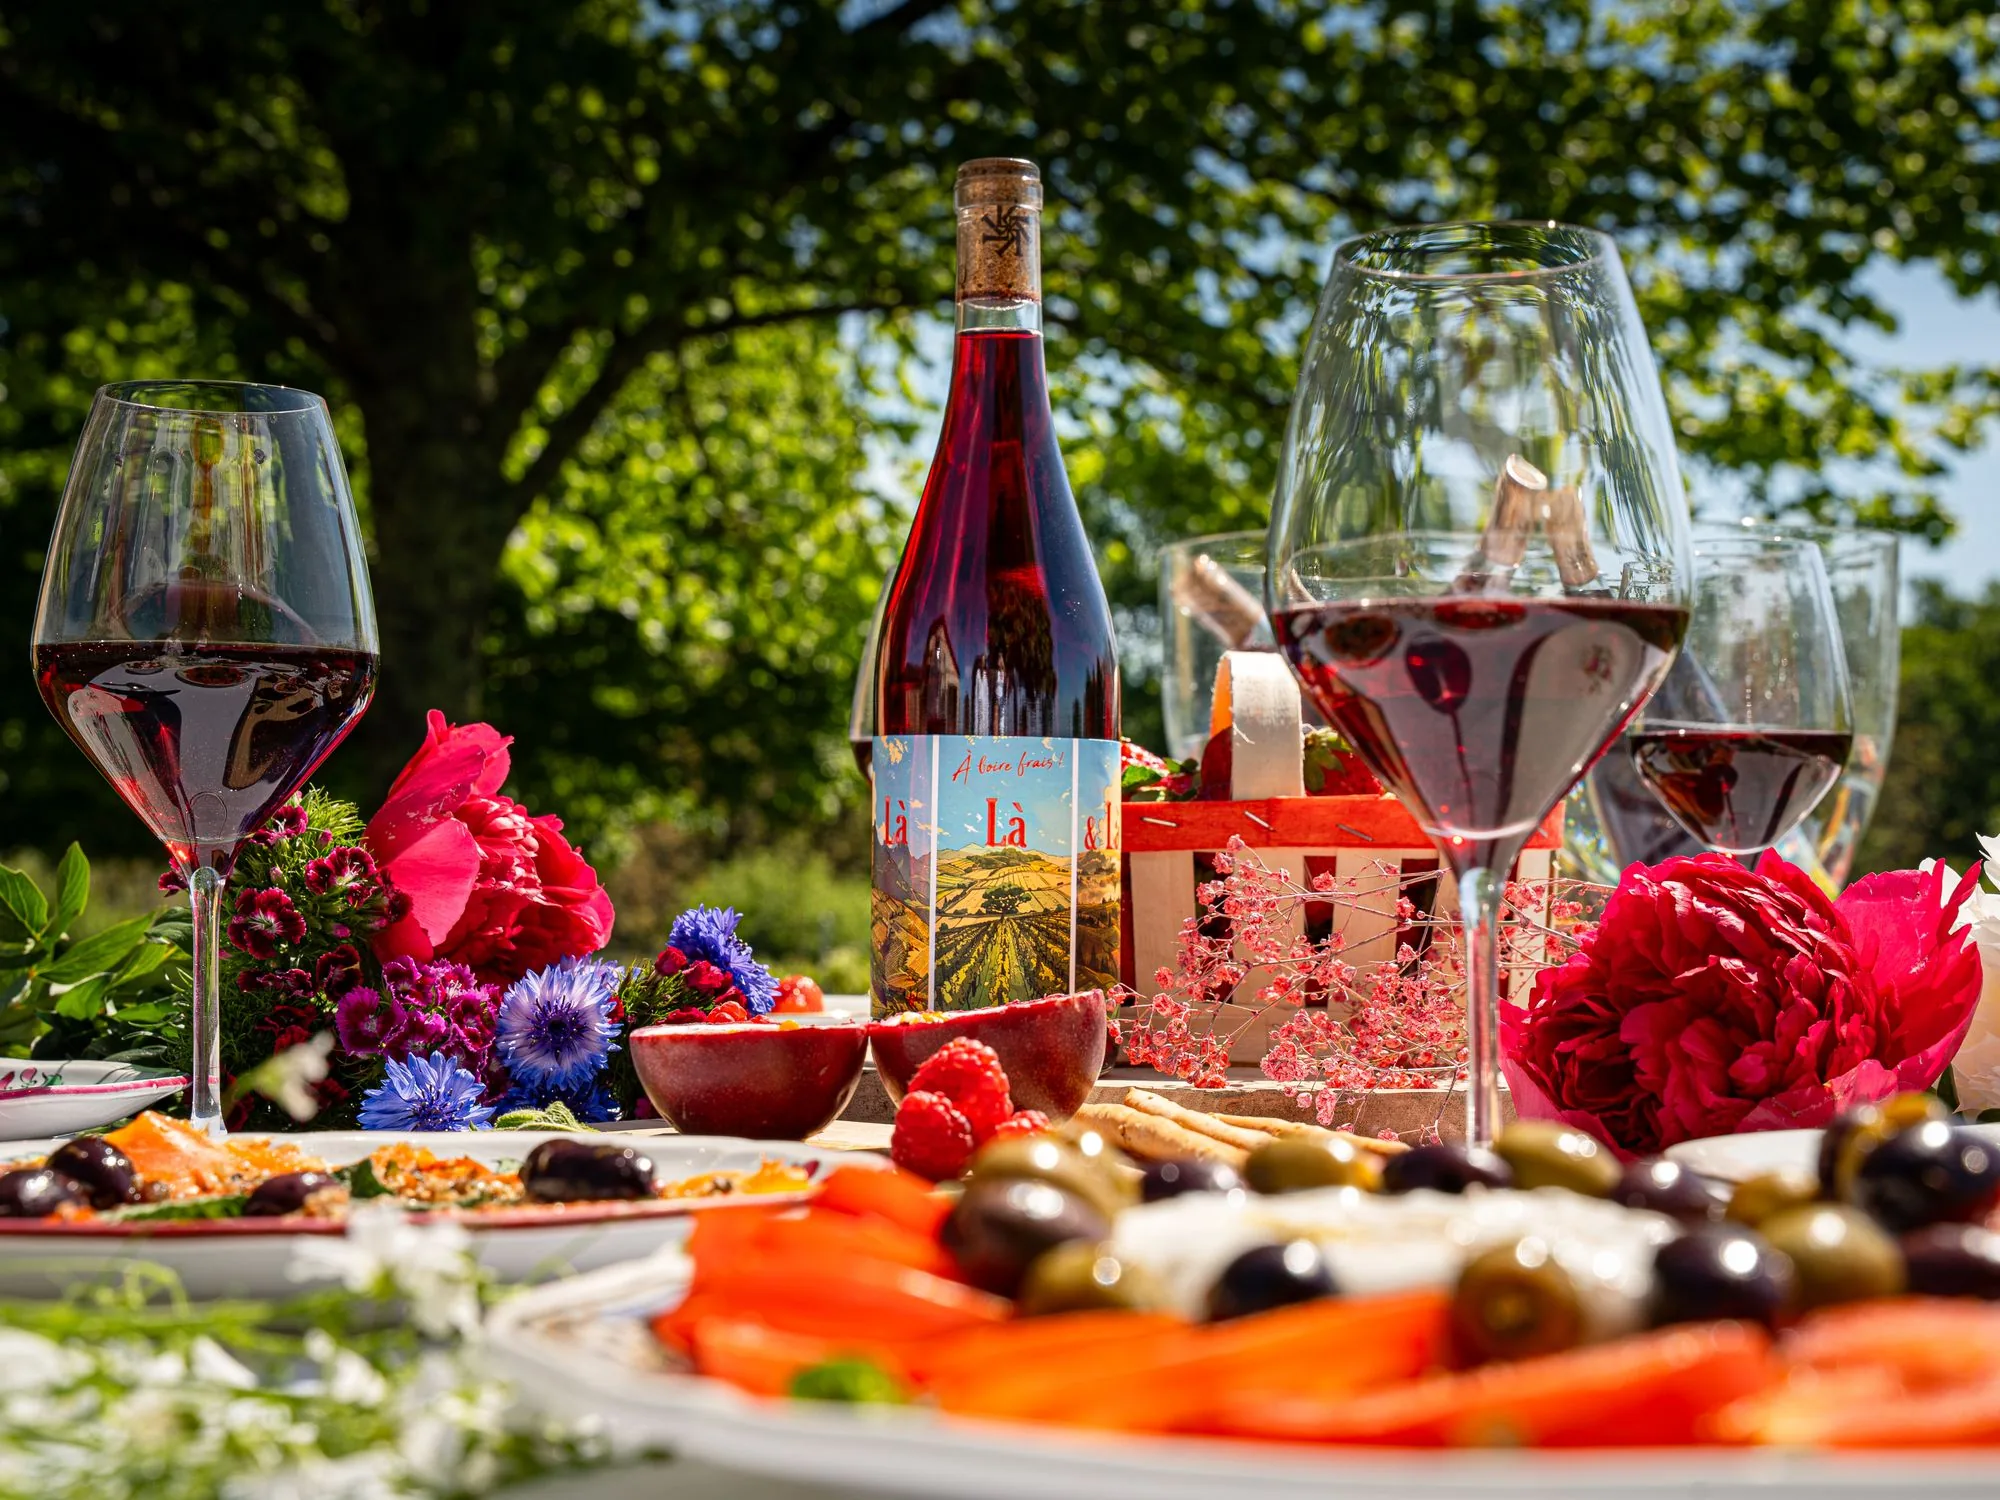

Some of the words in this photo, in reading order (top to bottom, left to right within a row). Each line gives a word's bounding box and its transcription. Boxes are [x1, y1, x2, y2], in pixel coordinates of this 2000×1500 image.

[952, 749, 972, 785] À
[977, 755, 1012, 774] boire
[985, 797, 1027, 848] Là
[1084, 815, 1097, 850] &
